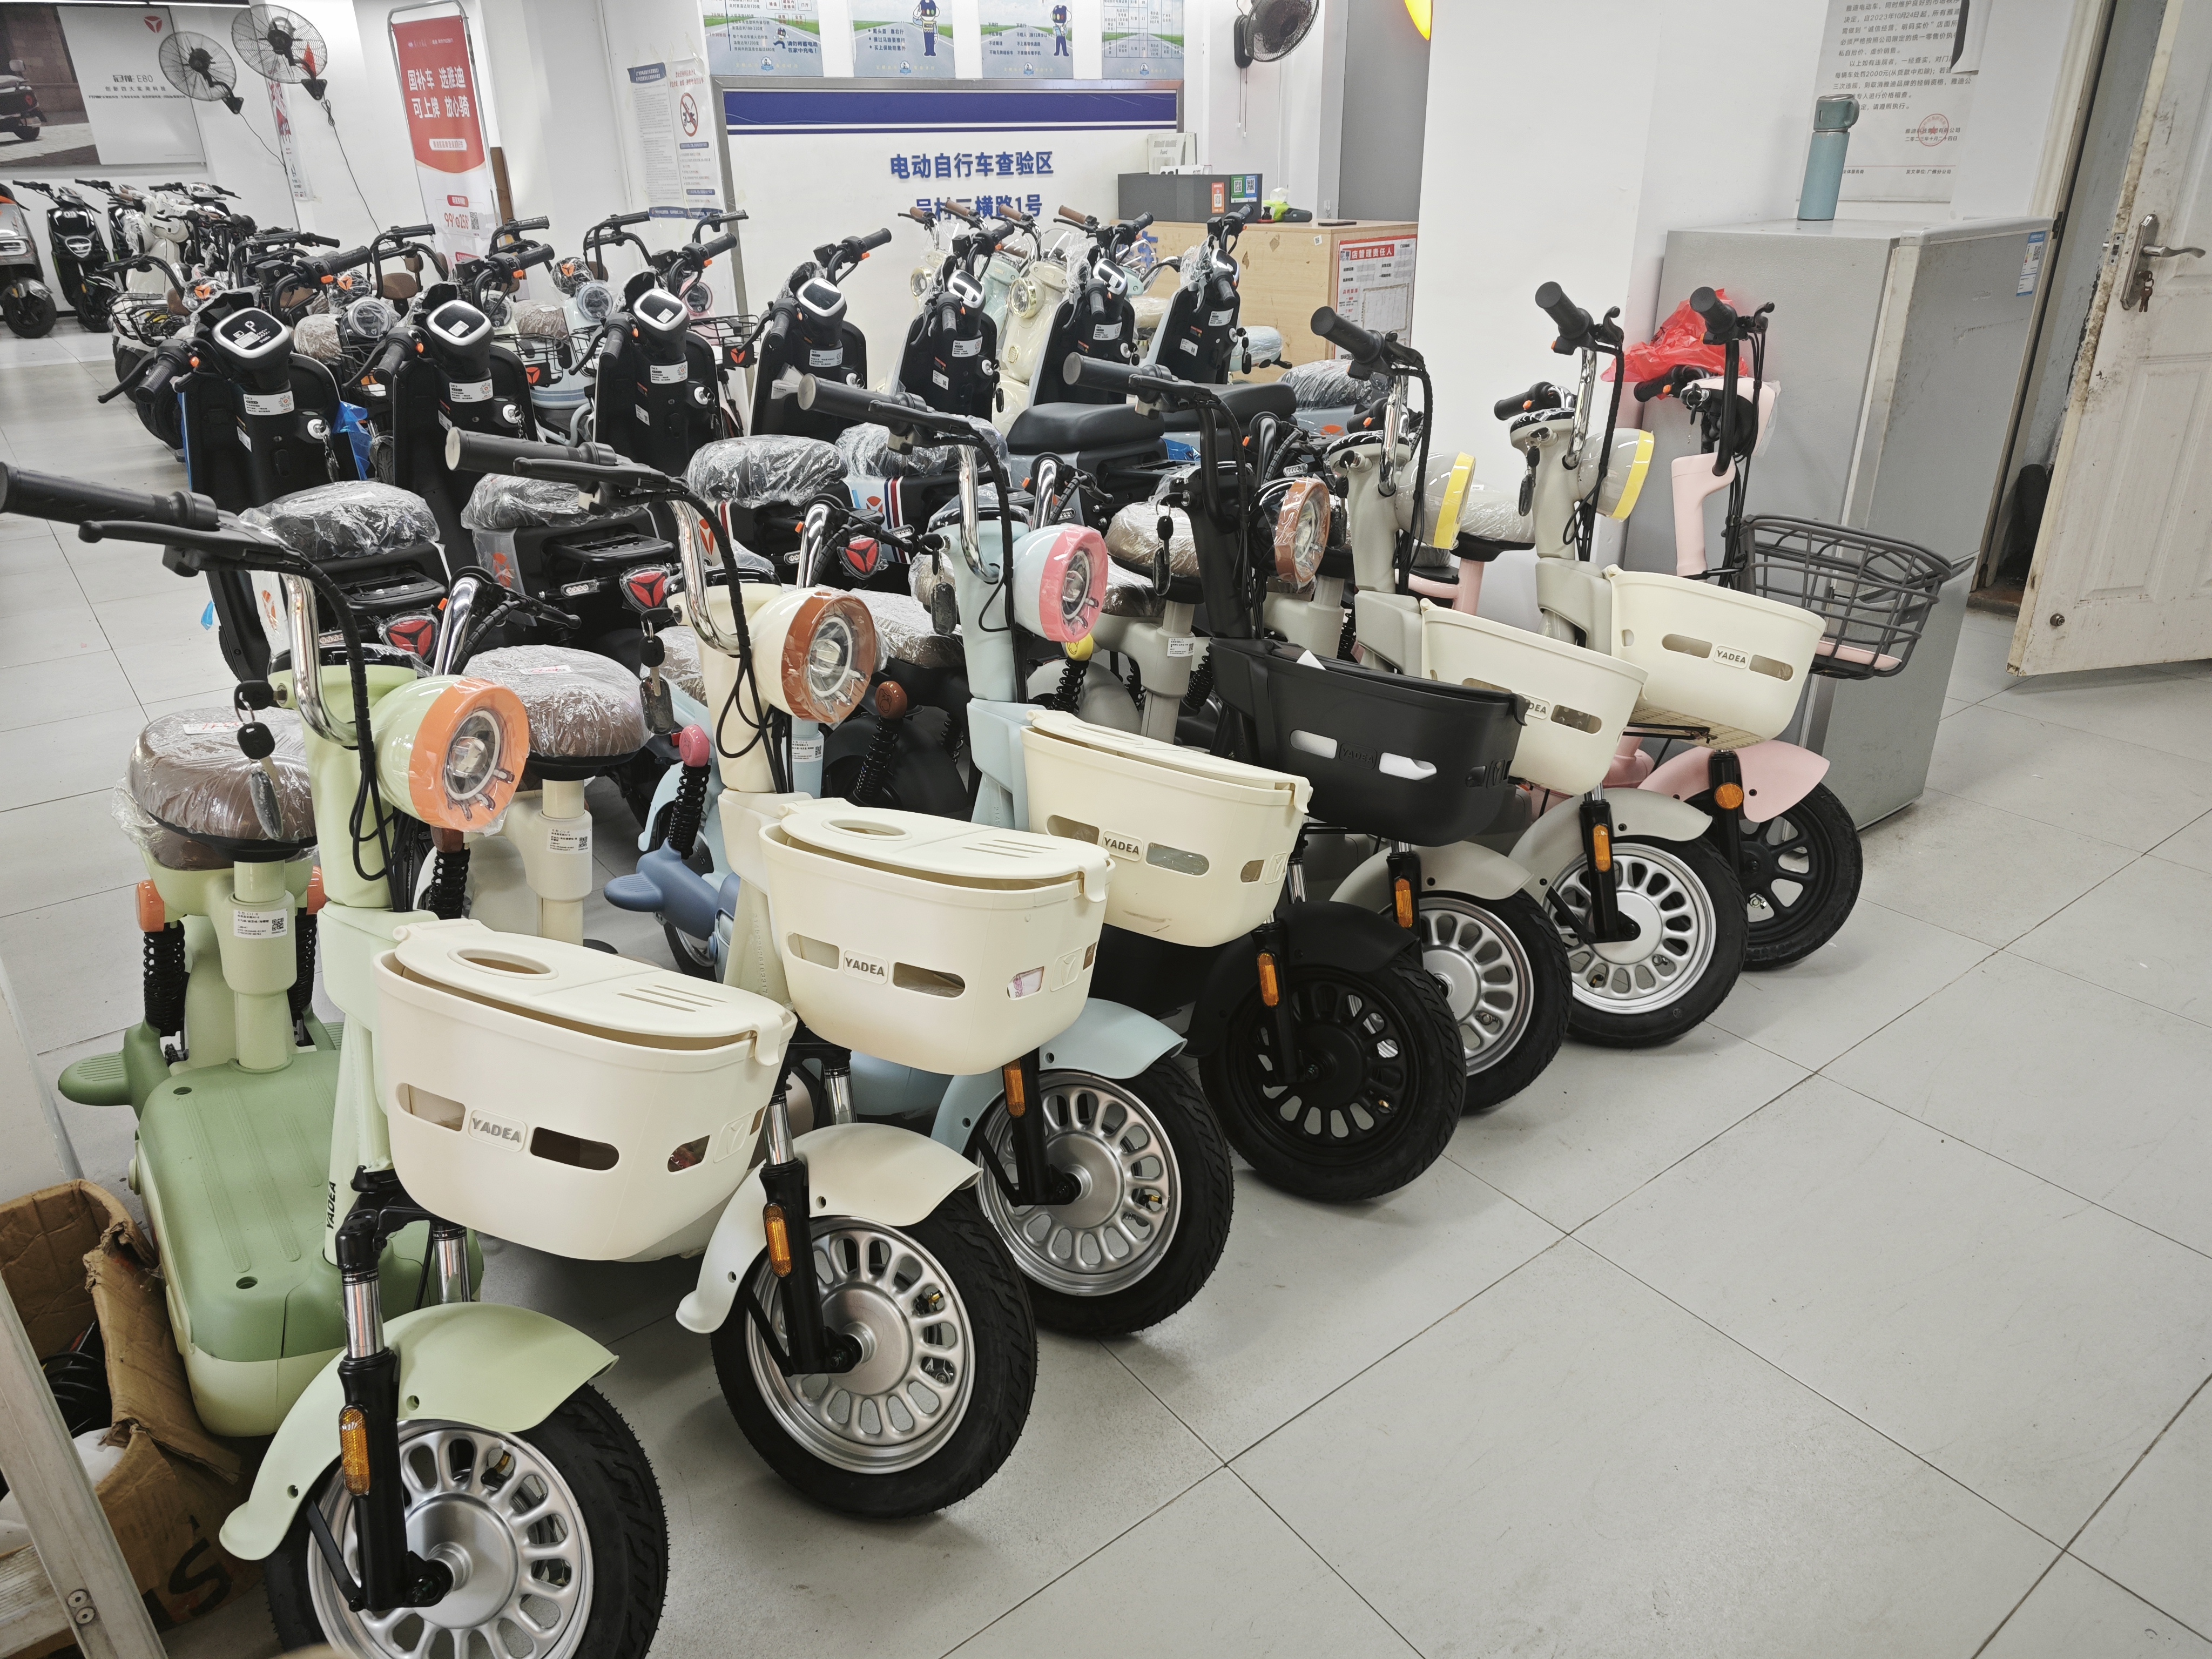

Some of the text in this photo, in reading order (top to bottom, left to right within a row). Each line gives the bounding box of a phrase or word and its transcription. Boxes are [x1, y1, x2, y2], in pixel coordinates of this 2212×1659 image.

[1849, 55, 1952, 66] 以上如有违规者，一经查实，对门
[136, 75, 153, 83] E80
[407, 65, 467, 91] 国补车 选雅迪
[411, 95, 470, 118] 可上牌 放心骑
[1859, 102, 1910, 111] 定，请遵照执行。
[890, 150, 1054, 179] 电动自行车查验区
[1717, 650, 1746, 664] YADEA
[1528, 703, 1547, 714] DEA
[1343, 748, 1374, 764] YADEA
[1104, 837, 1139, 855] YADEA
[845, 957, 885, 976] YADEA
[472, 1118, 522, 1143] YADEA
[326, 1181, 336, 1230] YADEA
